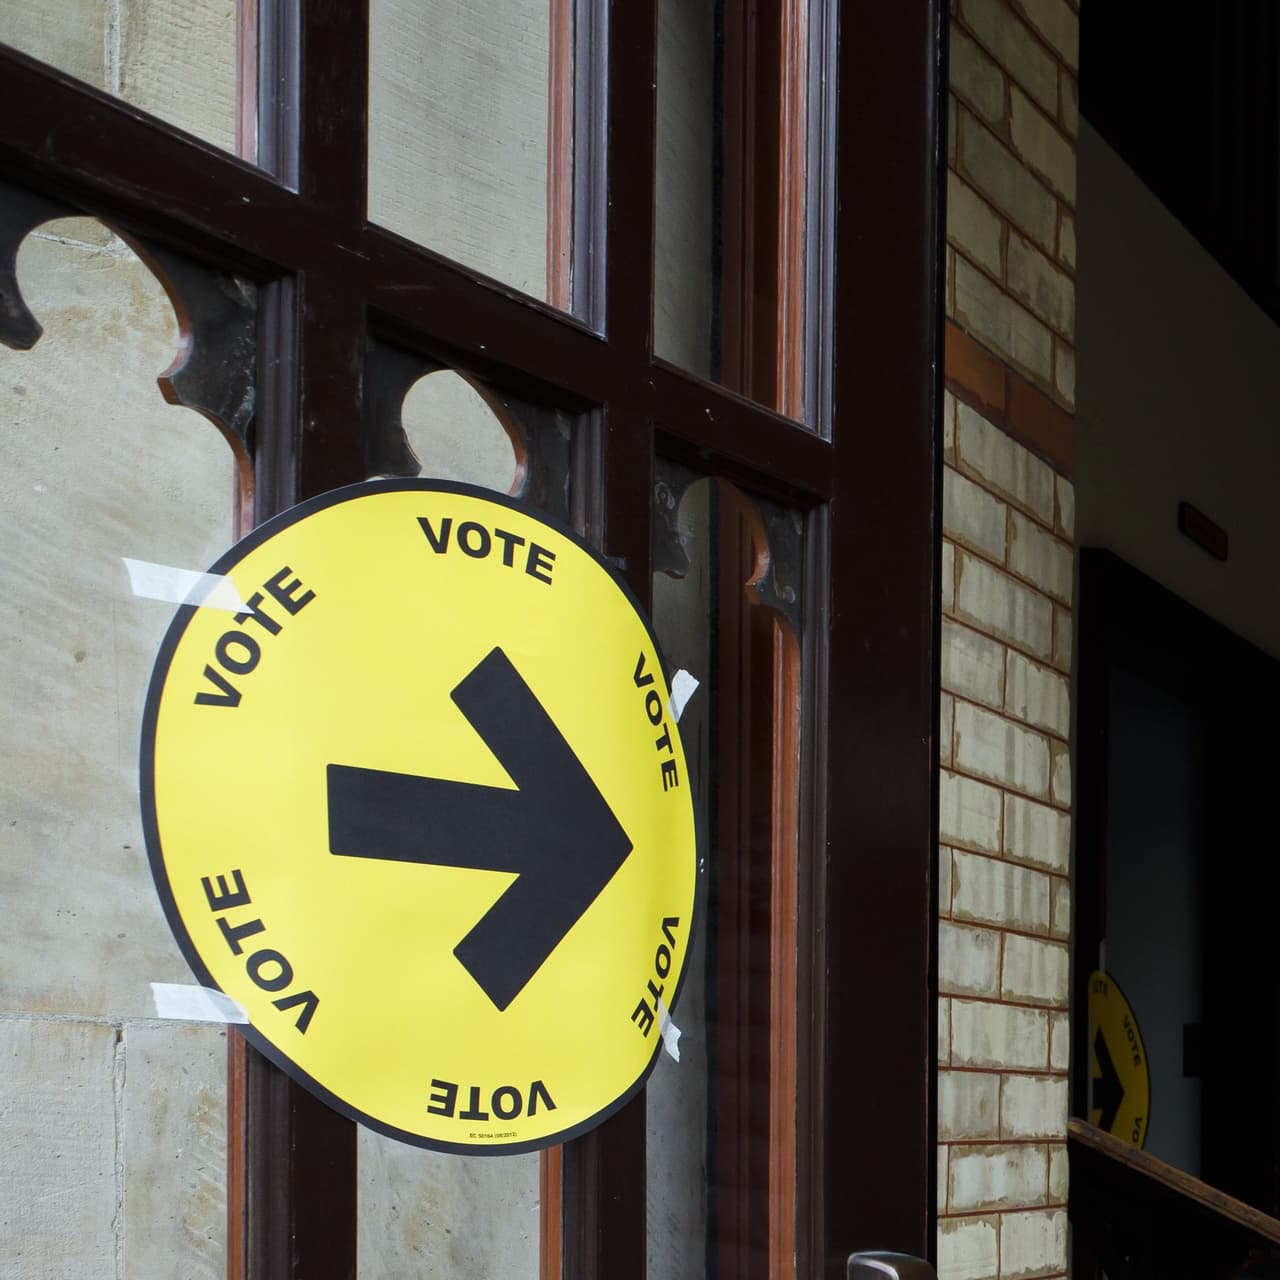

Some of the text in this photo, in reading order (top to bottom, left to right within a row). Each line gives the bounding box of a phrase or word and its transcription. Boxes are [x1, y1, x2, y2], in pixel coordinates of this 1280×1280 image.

[417, 517, 555, 584] VOTE
[195, 567, 315, 707] VOTE
[634, 652, 678, 791] VOTE
[202, 870, 319, 1034] VOTE
[631, 918, 679, 1037] VOTE
[428, 1079, 556, 1120] VOTE
[1123, 1016, 1142, 1067] VOTE
